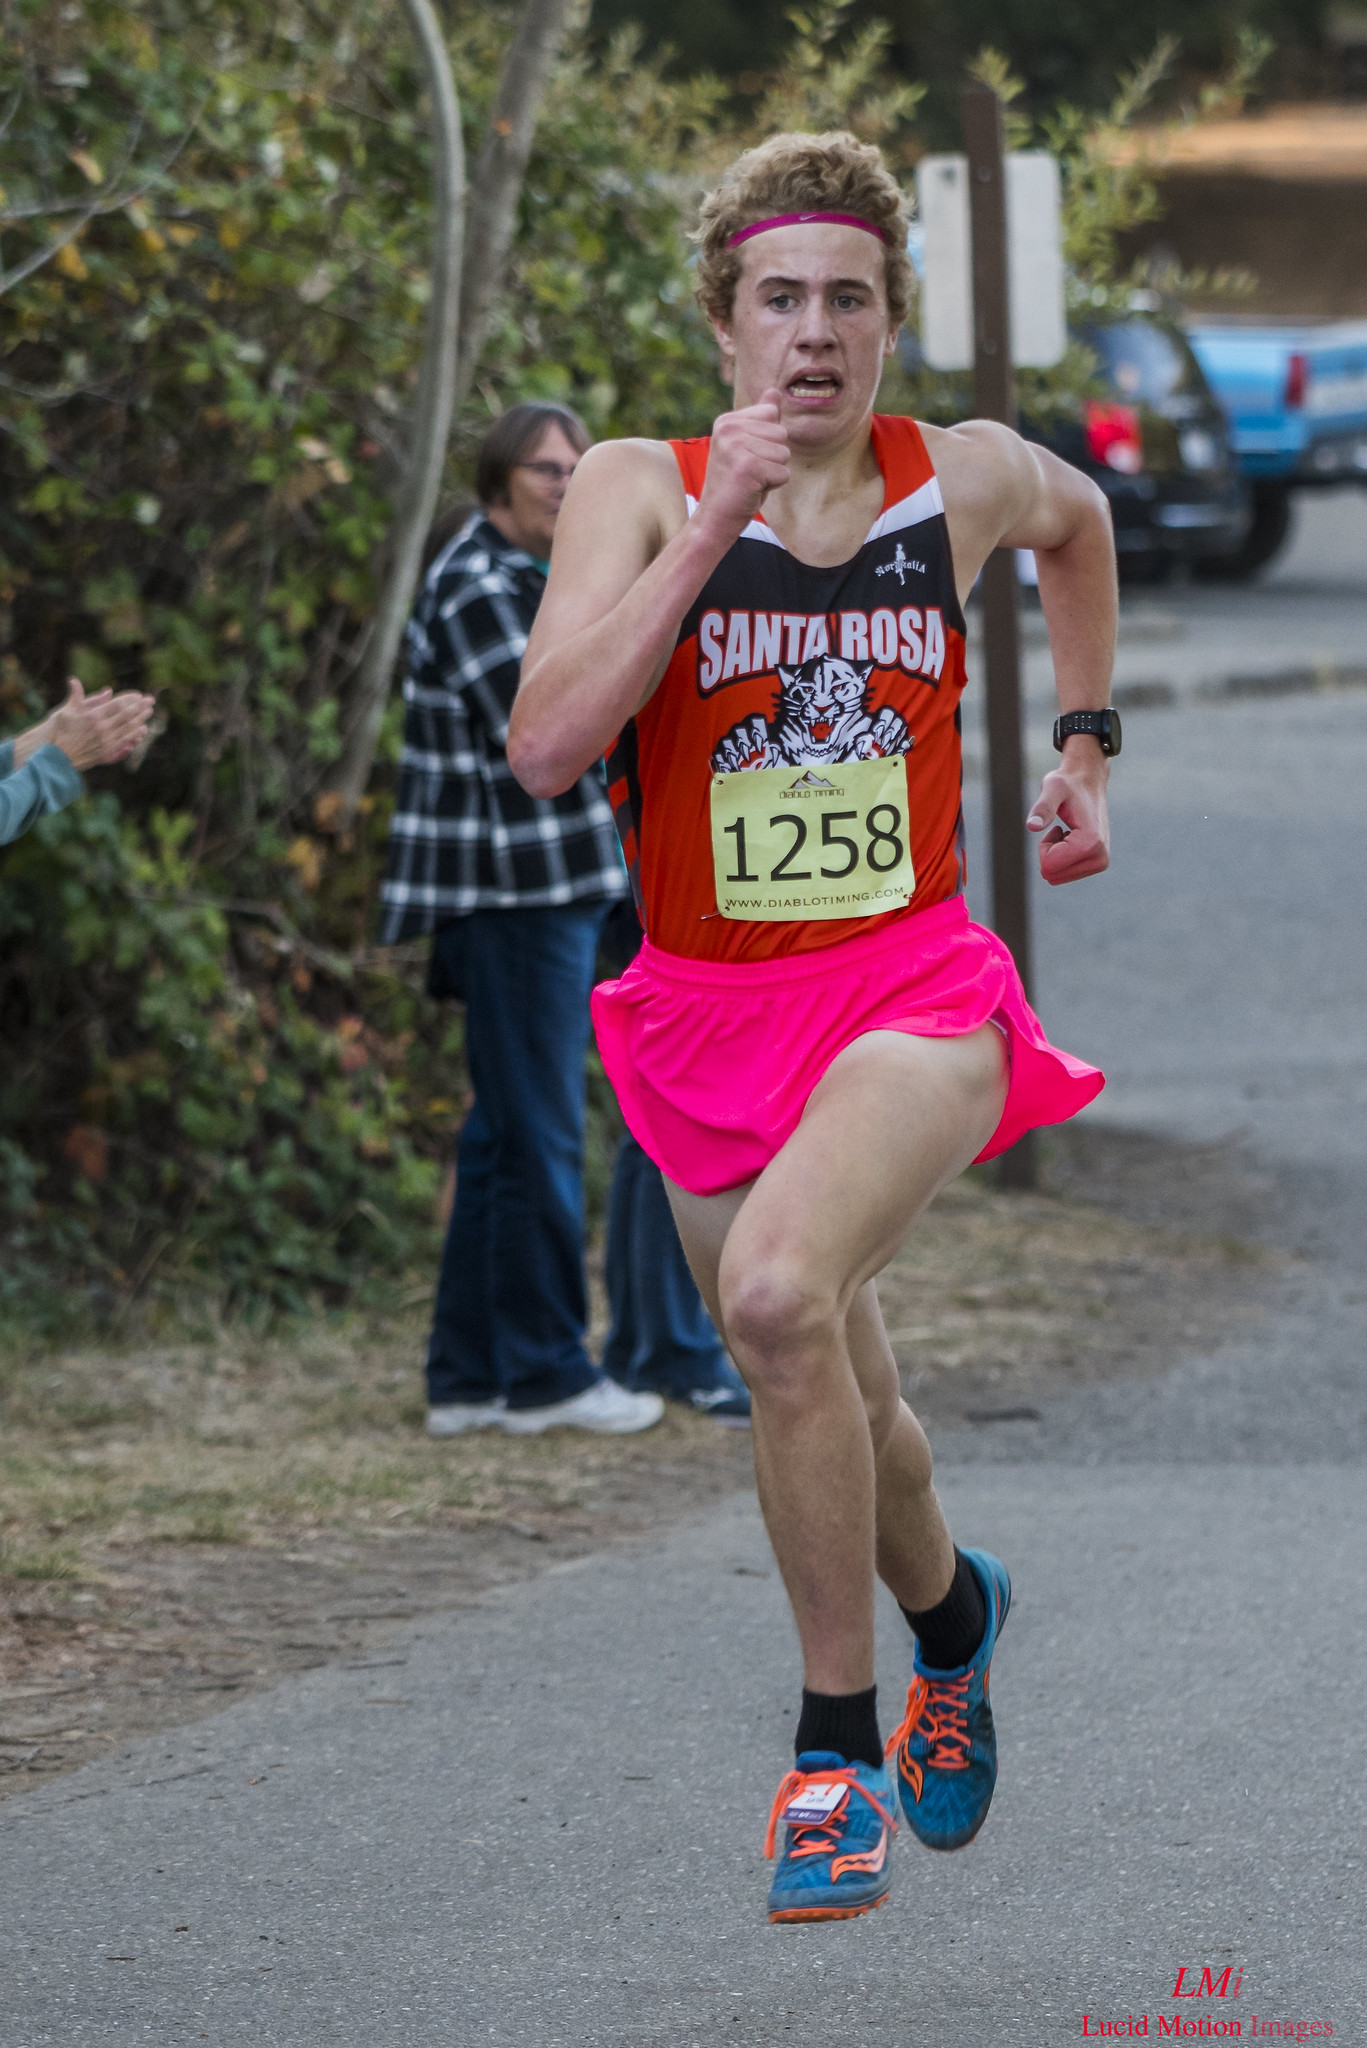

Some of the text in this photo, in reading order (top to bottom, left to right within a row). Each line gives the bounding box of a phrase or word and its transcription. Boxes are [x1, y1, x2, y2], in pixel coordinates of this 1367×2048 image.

[699, 607, 946, 691] SANTA ROSA
[723, 803, 904, 882] 1258
[725, 886, 904, 908] WWW.DIABLOTIMING.COM
